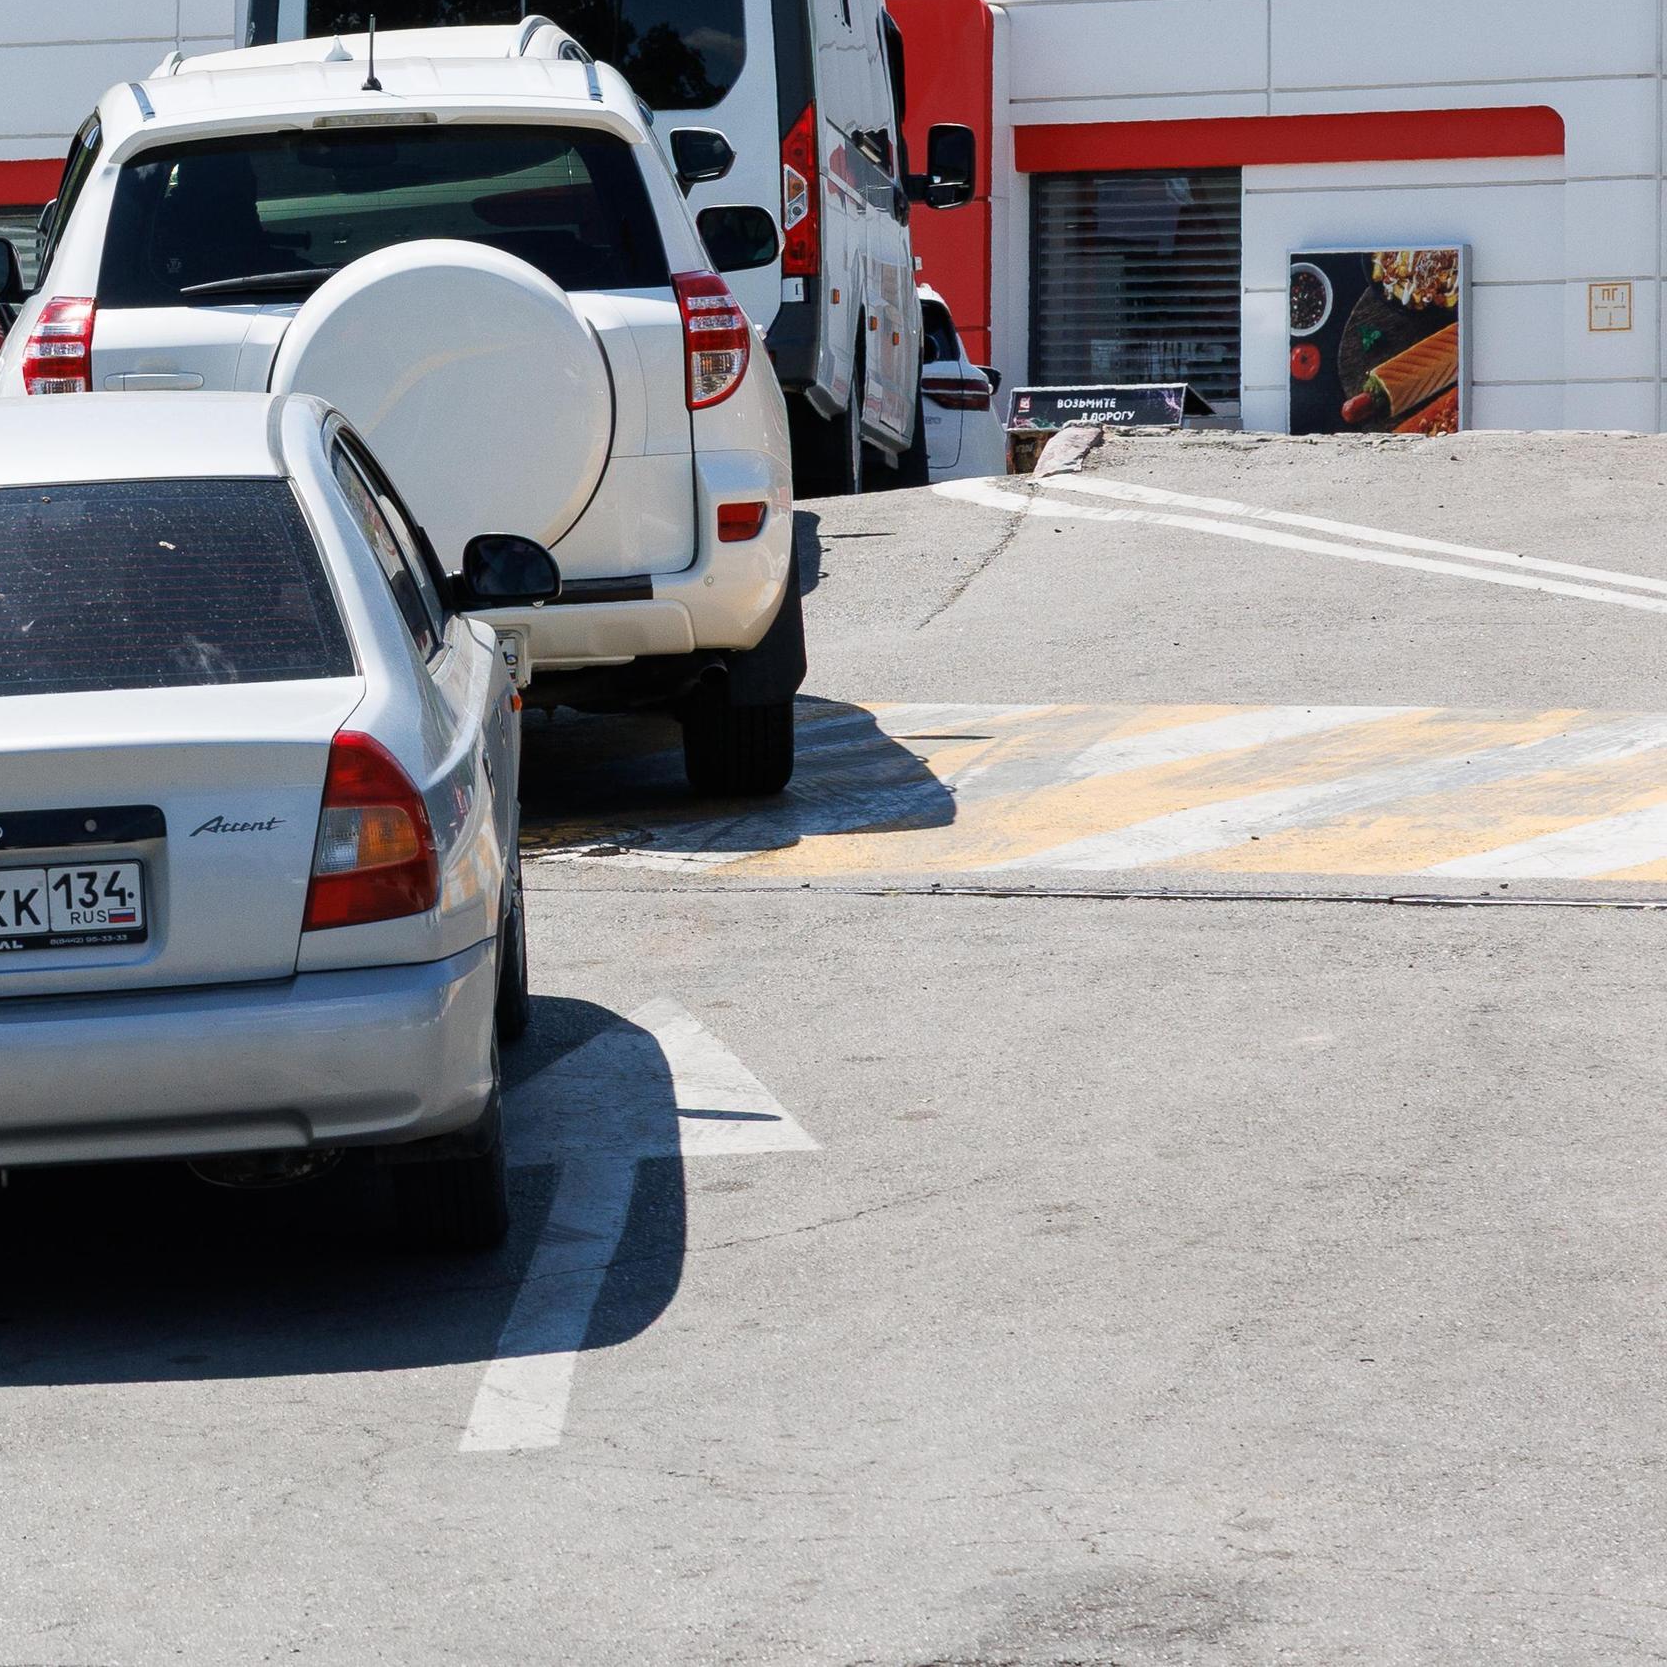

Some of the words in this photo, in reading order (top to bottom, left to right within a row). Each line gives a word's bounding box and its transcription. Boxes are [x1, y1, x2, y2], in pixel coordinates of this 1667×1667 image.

[1057, 398, 1116, 409] ВОЗЬМИТЕ
[189, 815, 287, 837] Accent
[53, 870, 128, 910] 134
[70, 908, 107, 925] RUS
